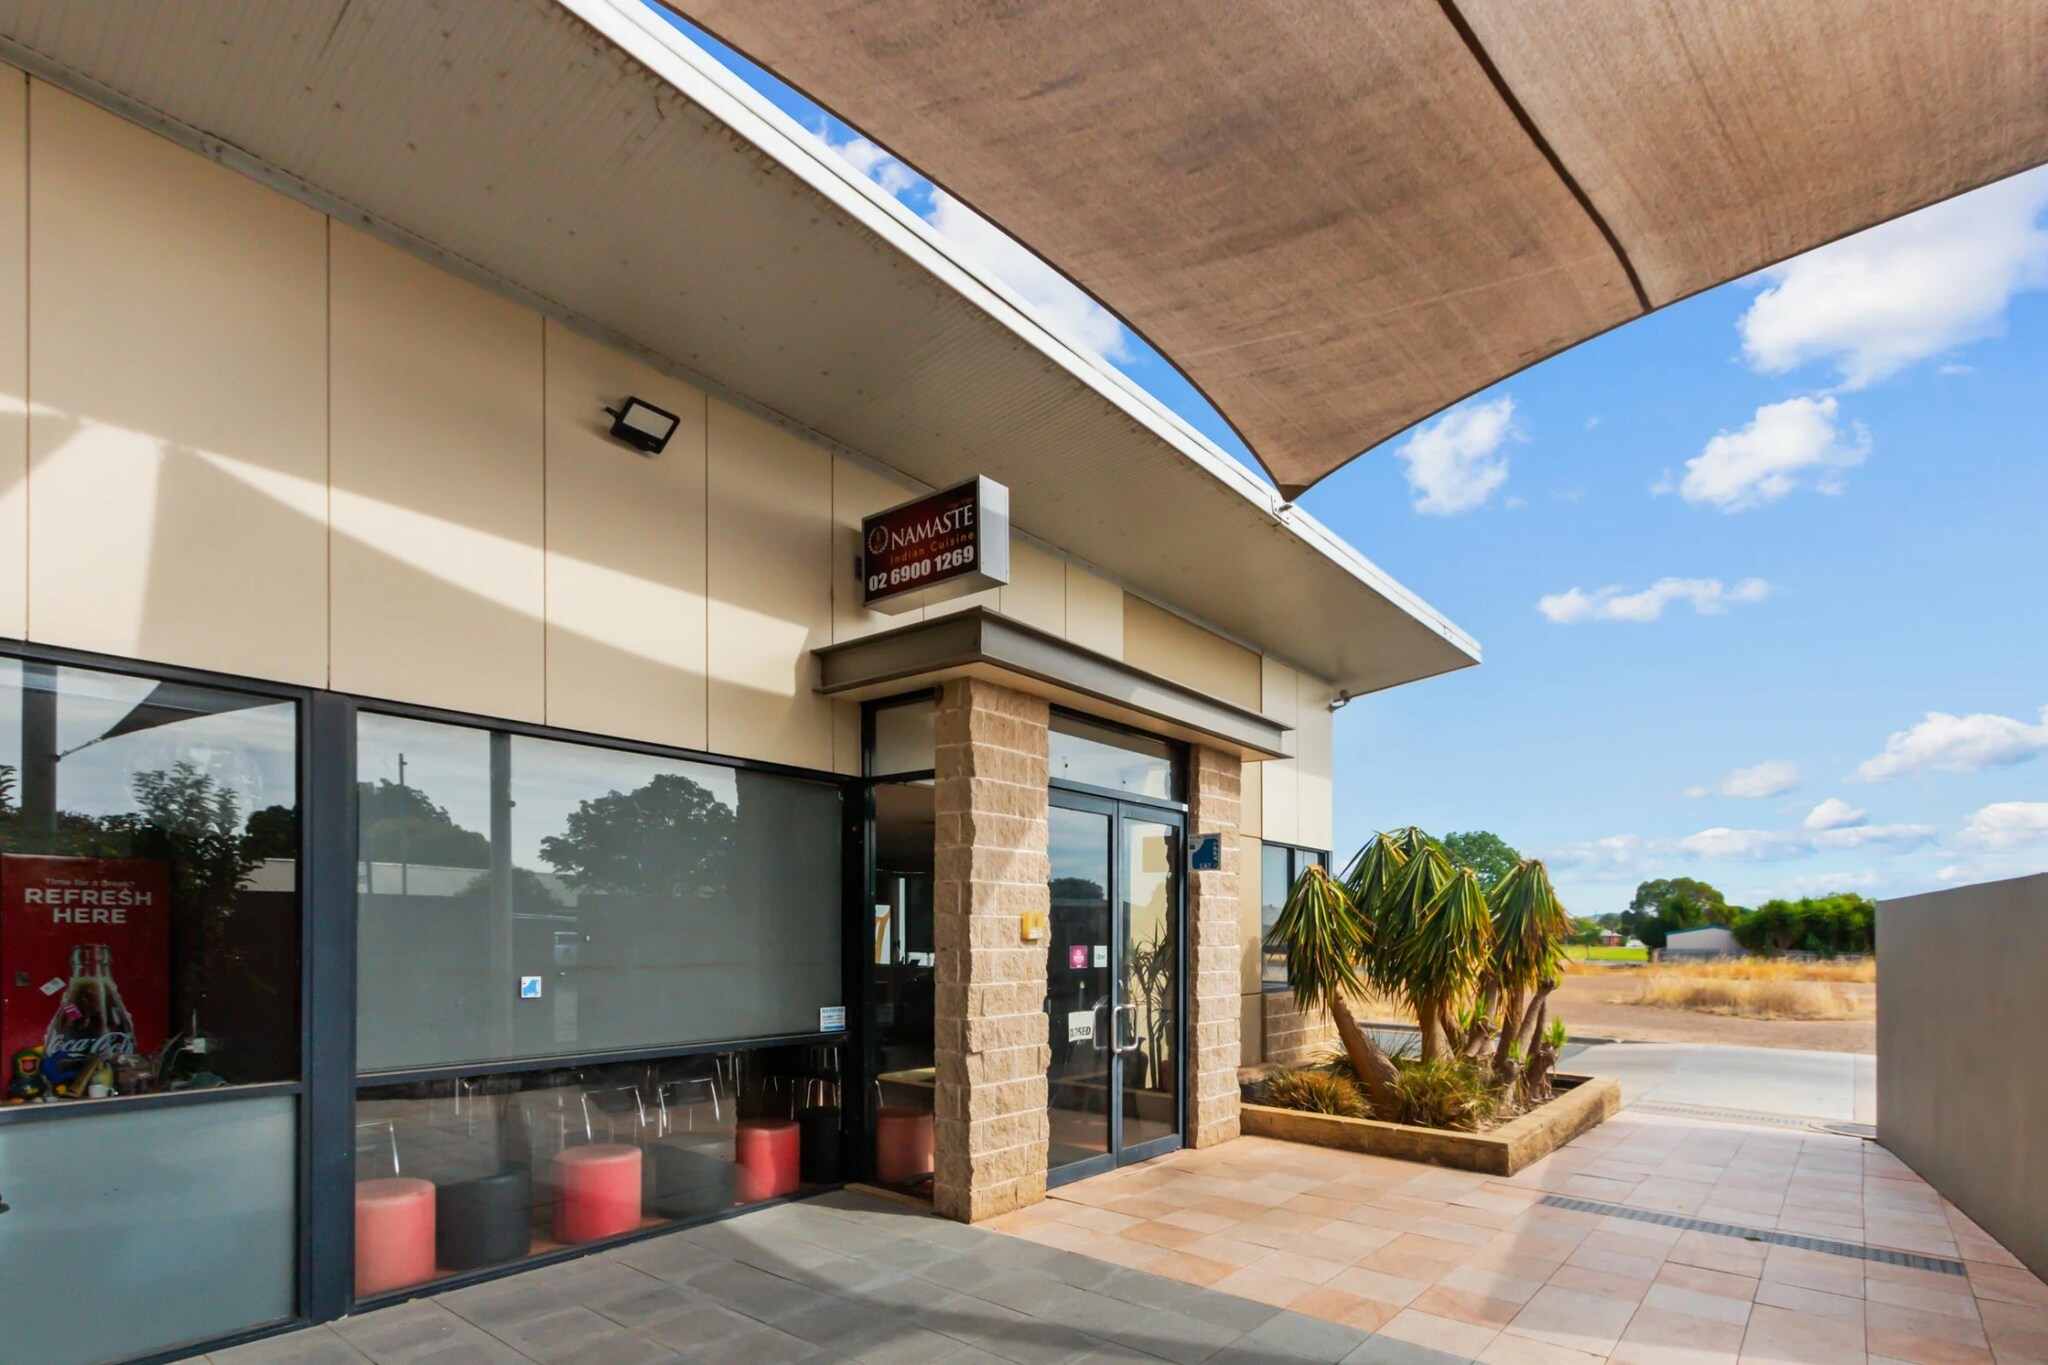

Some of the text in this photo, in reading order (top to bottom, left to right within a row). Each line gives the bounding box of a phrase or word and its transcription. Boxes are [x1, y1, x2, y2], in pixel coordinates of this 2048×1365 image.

[891, 504, 974, 550] NAMASTE
[890, 531, 975, 565] Indian Cuisine
[869, 545, 975, 592] 02 6900 1269
[45, 877, 71, 886] Time
[24, 887, 152, 906] REFRESH
[53, 907, 127, 923] HERE
